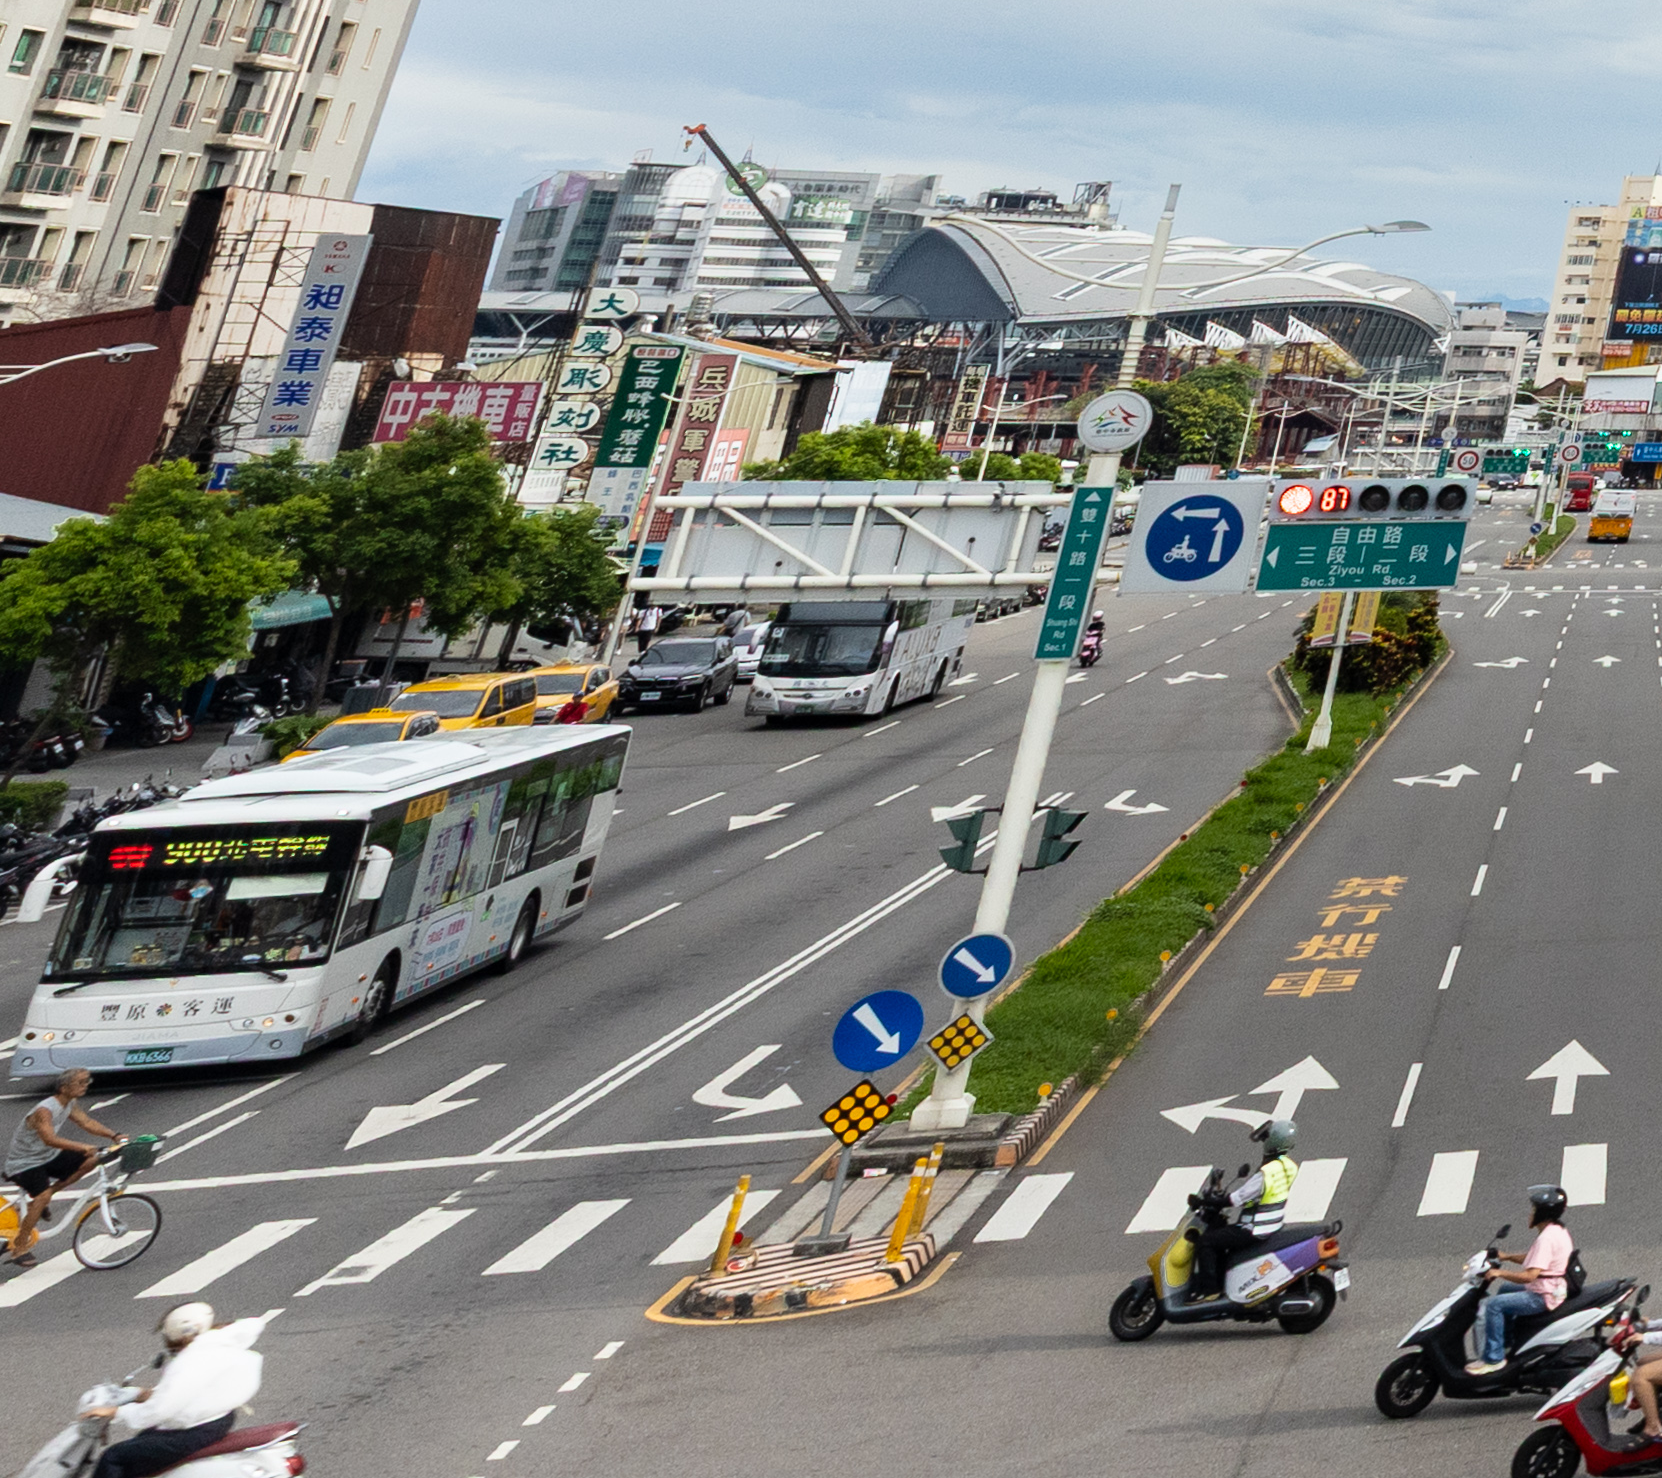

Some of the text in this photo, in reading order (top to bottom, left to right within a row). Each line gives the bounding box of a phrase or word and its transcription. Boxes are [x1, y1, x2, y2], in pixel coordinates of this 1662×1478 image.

[267, 424, 298, 434] SYM
[1463, 456, 1475, 465] 50
[1320, 486, 1351, 512] 87
[1332, 526, 1404, 544] 自由路
[1057, 507, 1099, 611] 雙十路一段
[1329, 564, 1365, 576] Ziyou
[1300, 574, 1417, 588] Sec.3 Sec.2
[1053, 630, 1066, 639] Rd
[1044, 642, 1067, 652] Sec.1
[1264, 875, 1409, 998] 禁行機車
